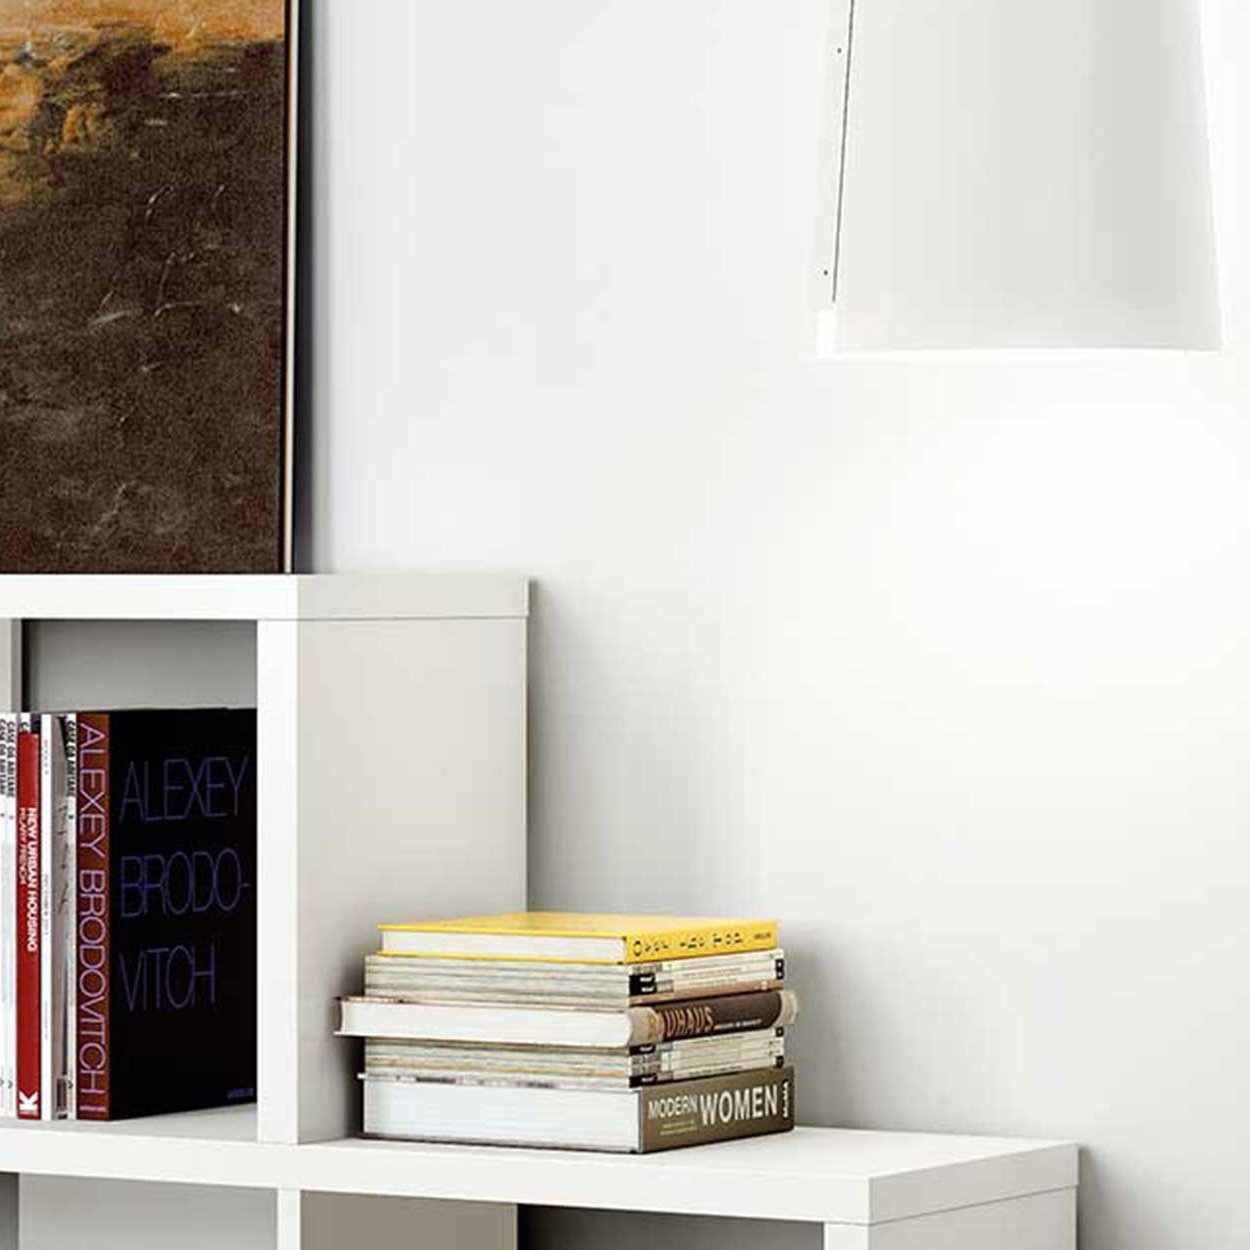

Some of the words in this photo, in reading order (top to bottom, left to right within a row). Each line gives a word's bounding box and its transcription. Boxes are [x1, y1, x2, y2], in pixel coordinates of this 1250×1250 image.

[79, 722, 106, 858] ALEXEY
[120, 755, 248, 824] ALEXEY
[27, 807, 37, 838] NEW
[27, 841, 37, 887] URBAN
[121, 848, 251, 918] BRODO-
[27, 890, 37, 952] HOUSING
[79, 870, 106, 1095] BRODOVITCH
[120, 945, 217, 1012] VITCH
[657, 1006, 714, 1040] UHAUS
[648, 1094, 698, 1120] MODERN
[700, 1084, 778, 1126] WOMEN
